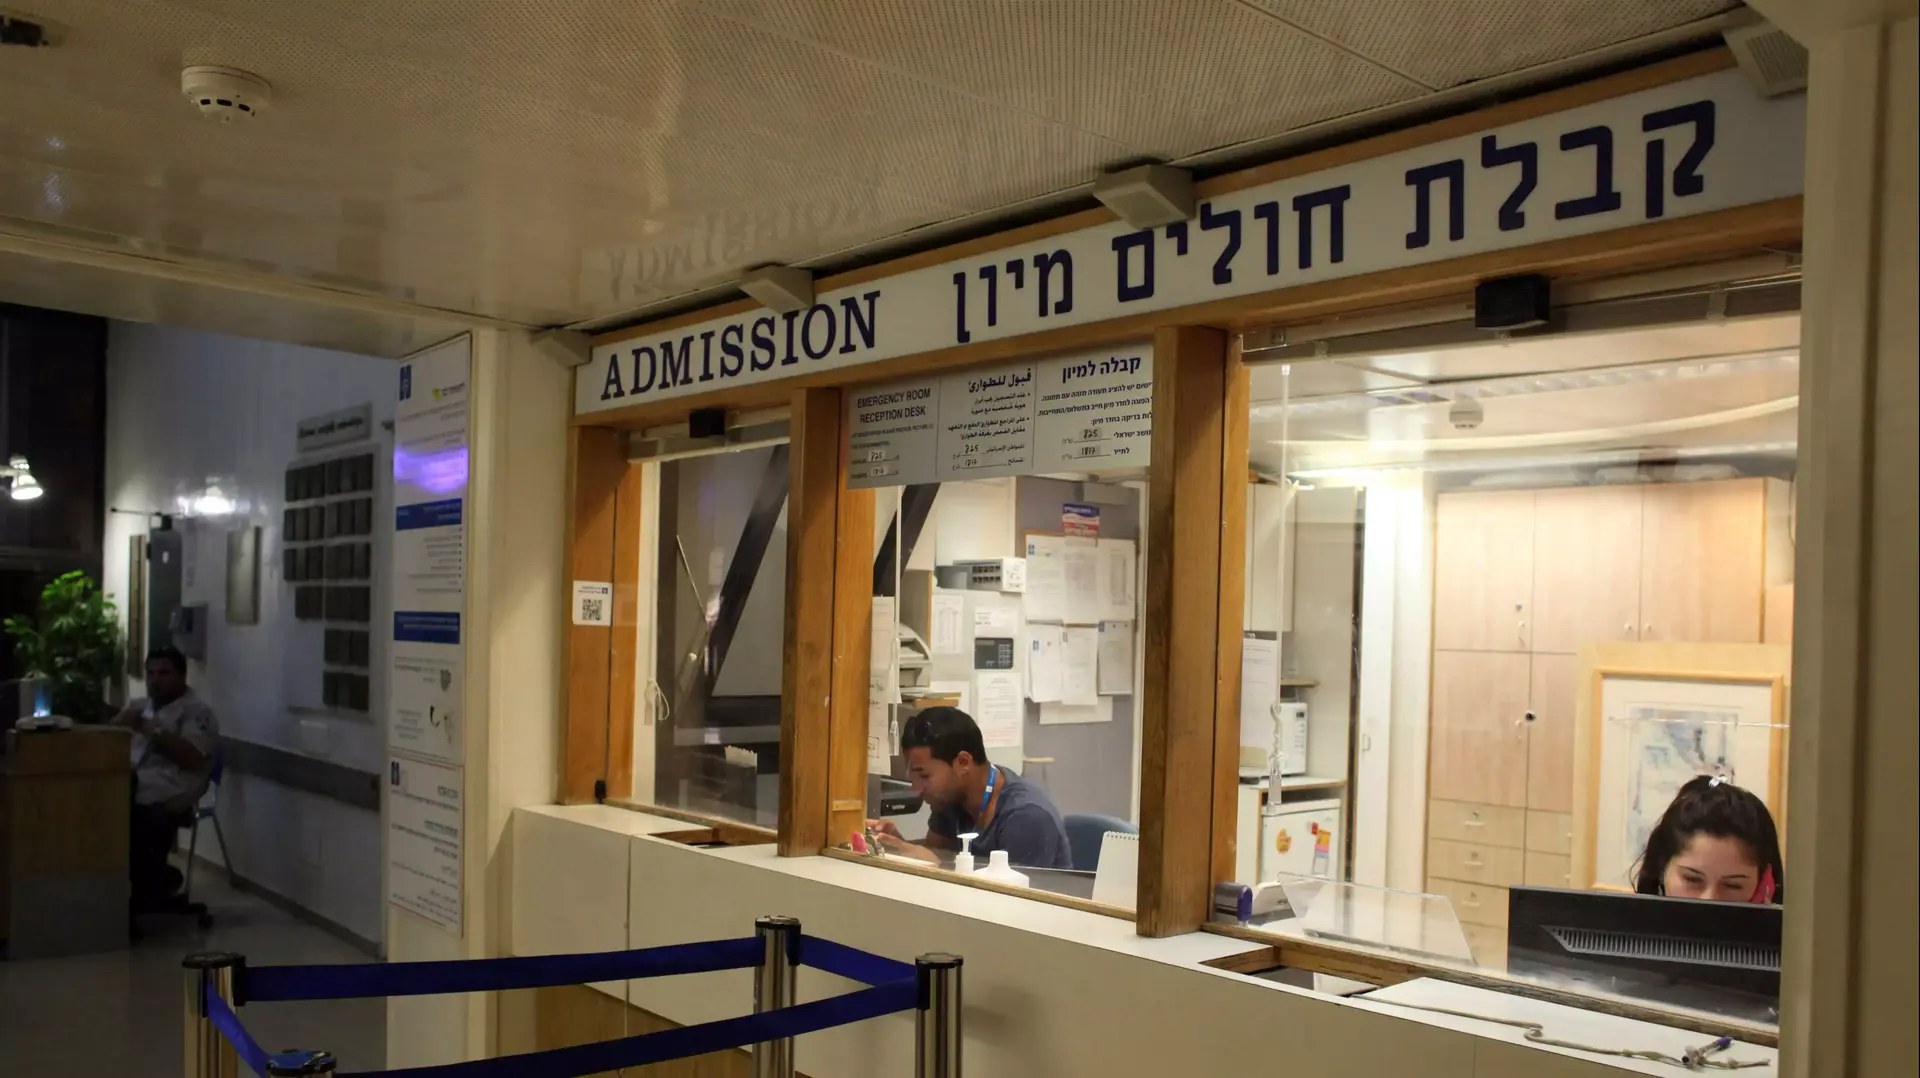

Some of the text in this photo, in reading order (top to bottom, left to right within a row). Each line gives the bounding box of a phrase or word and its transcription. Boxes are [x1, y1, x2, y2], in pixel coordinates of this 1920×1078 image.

[953, 98, 1717, 343] קבלת חולים מיון
[601, 290, 881, 400] ADMISSION
[1008, 367, 1031, 388] قبول
[1062, 357, 1141, 384] קבלה למיון
[1108, 384, 1125, 393] להציג
[857, 387, 931, 408] EMERGENCY ROOM
[1115, 399, 1130, 407] לחדר
[859, 405, 926, 423] RECEPTION DESK
[1121, 414, 1140, 422] בדיקה
[1083, 429, 1098, 438] 825
[965, 444, 979, 454] 825
[1113, 446, 1130, 455] לתייר
